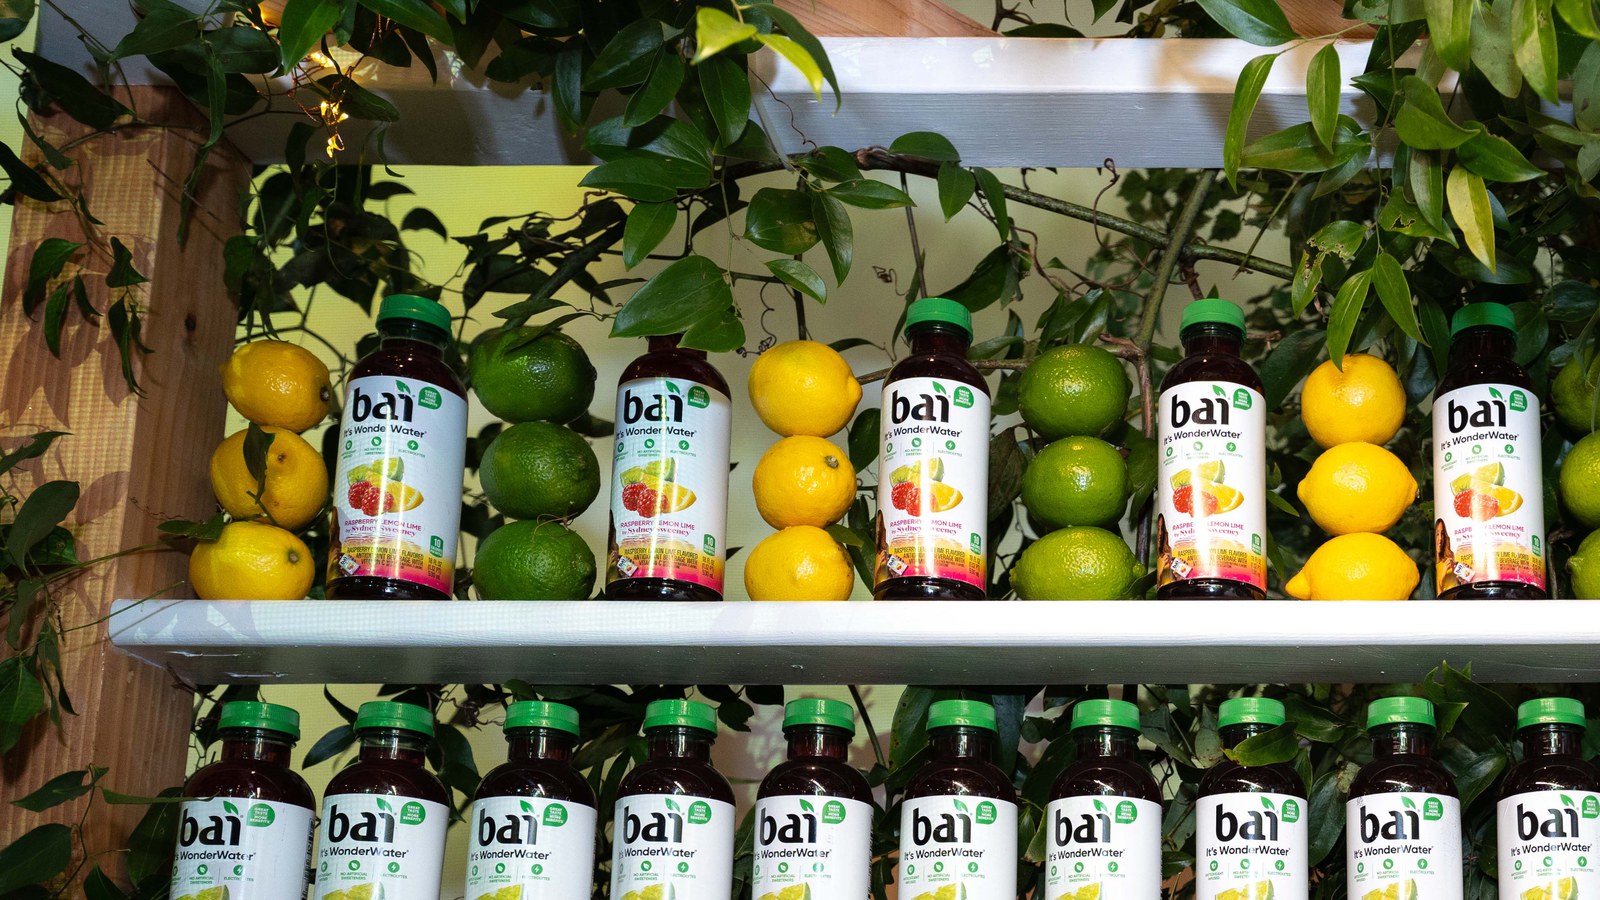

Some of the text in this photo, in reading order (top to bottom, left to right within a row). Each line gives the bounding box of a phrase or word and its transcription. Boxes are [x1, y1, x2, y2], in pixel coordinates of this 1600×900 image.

[352, 387, 413, 422] bai
[624, 389, 683, 424] bai
[892, 390, 949, 424] bai
[1171, 394, 1229, 428] bai
[1448, 399, 1507, 434] bai
[354, 424, 424, 438] WondeWater
[625, 426, 695, 438] WonderWater
[893, 425, 960, 438] WonderWater
[1164, 429, 1240, 445] It's WonderWater
[1440, 431, 1517, 450] It's WonderWater
[407, 523, 422, 532] LIME
[620, 520, 653, 528] RASPBERRY
[681, 522, 695, 530] LIME
[890, 519, 921, 527] RASPBERRY
[897, 525, 921, 533] Sydney
[351, 525, 377, 533] Sydney
[381, 527, 416, 537] Sweney
[180, 808, 241, 847] bai
[329, 804, 394, 843] bai
[478, 808, 537, 846] bai
[623, 806, 682, 844] bai
[760, 808, 817, 846] bai
[913, 808, 971, 846] bai
[1056, 809, 1111, 847] bai
[1216, 804, 1278, 842] bai
[1360, 805, 1419, 843] bai
[1517, 803, 1579, 841] bai
[180, 851, 253, 860] WonderWater
[330, 847, 406, 858] WonderWater
[480, 849, 549, 860] WonderWater
[625, 847, 694, 857] WonderWater
[761, 849, 829, 858] WonderWater
[904, 848, 983, 860] It's WonderWater
[1058, 848, 1122, 860] WonderWater
[1206, 845, 1289, 856] It's WonderWater
[1354, 845, 1431, 859] It's WonderWater
[1511, 843, 1590, 856] It's WonderWater
